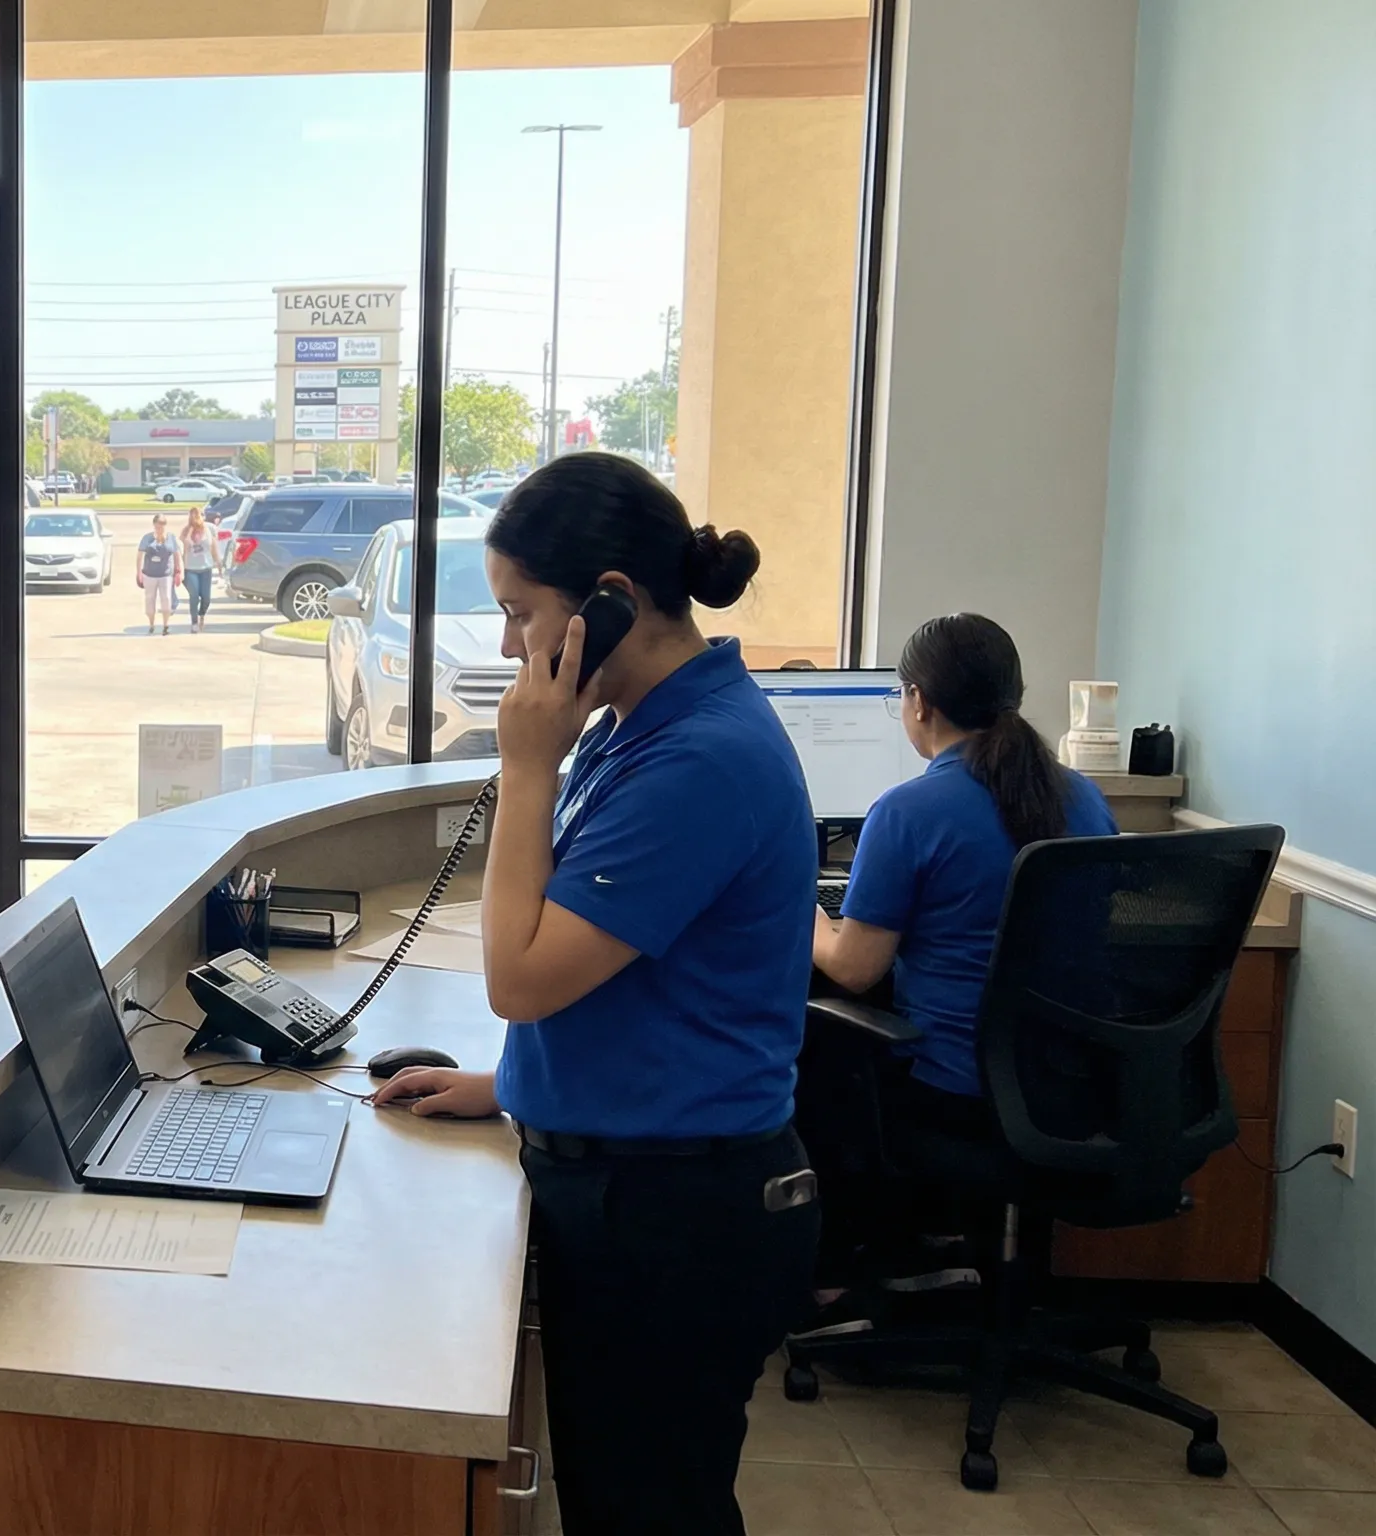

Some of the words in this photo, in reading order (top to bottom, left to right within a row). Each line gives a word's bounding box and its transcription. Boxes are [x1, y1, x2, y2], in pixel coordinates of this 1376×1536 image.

[285, 295, 350, 309] LEAGUE
[355, 294, 395, 308] CITY
[311, 312, 367, 325] PLAZA
